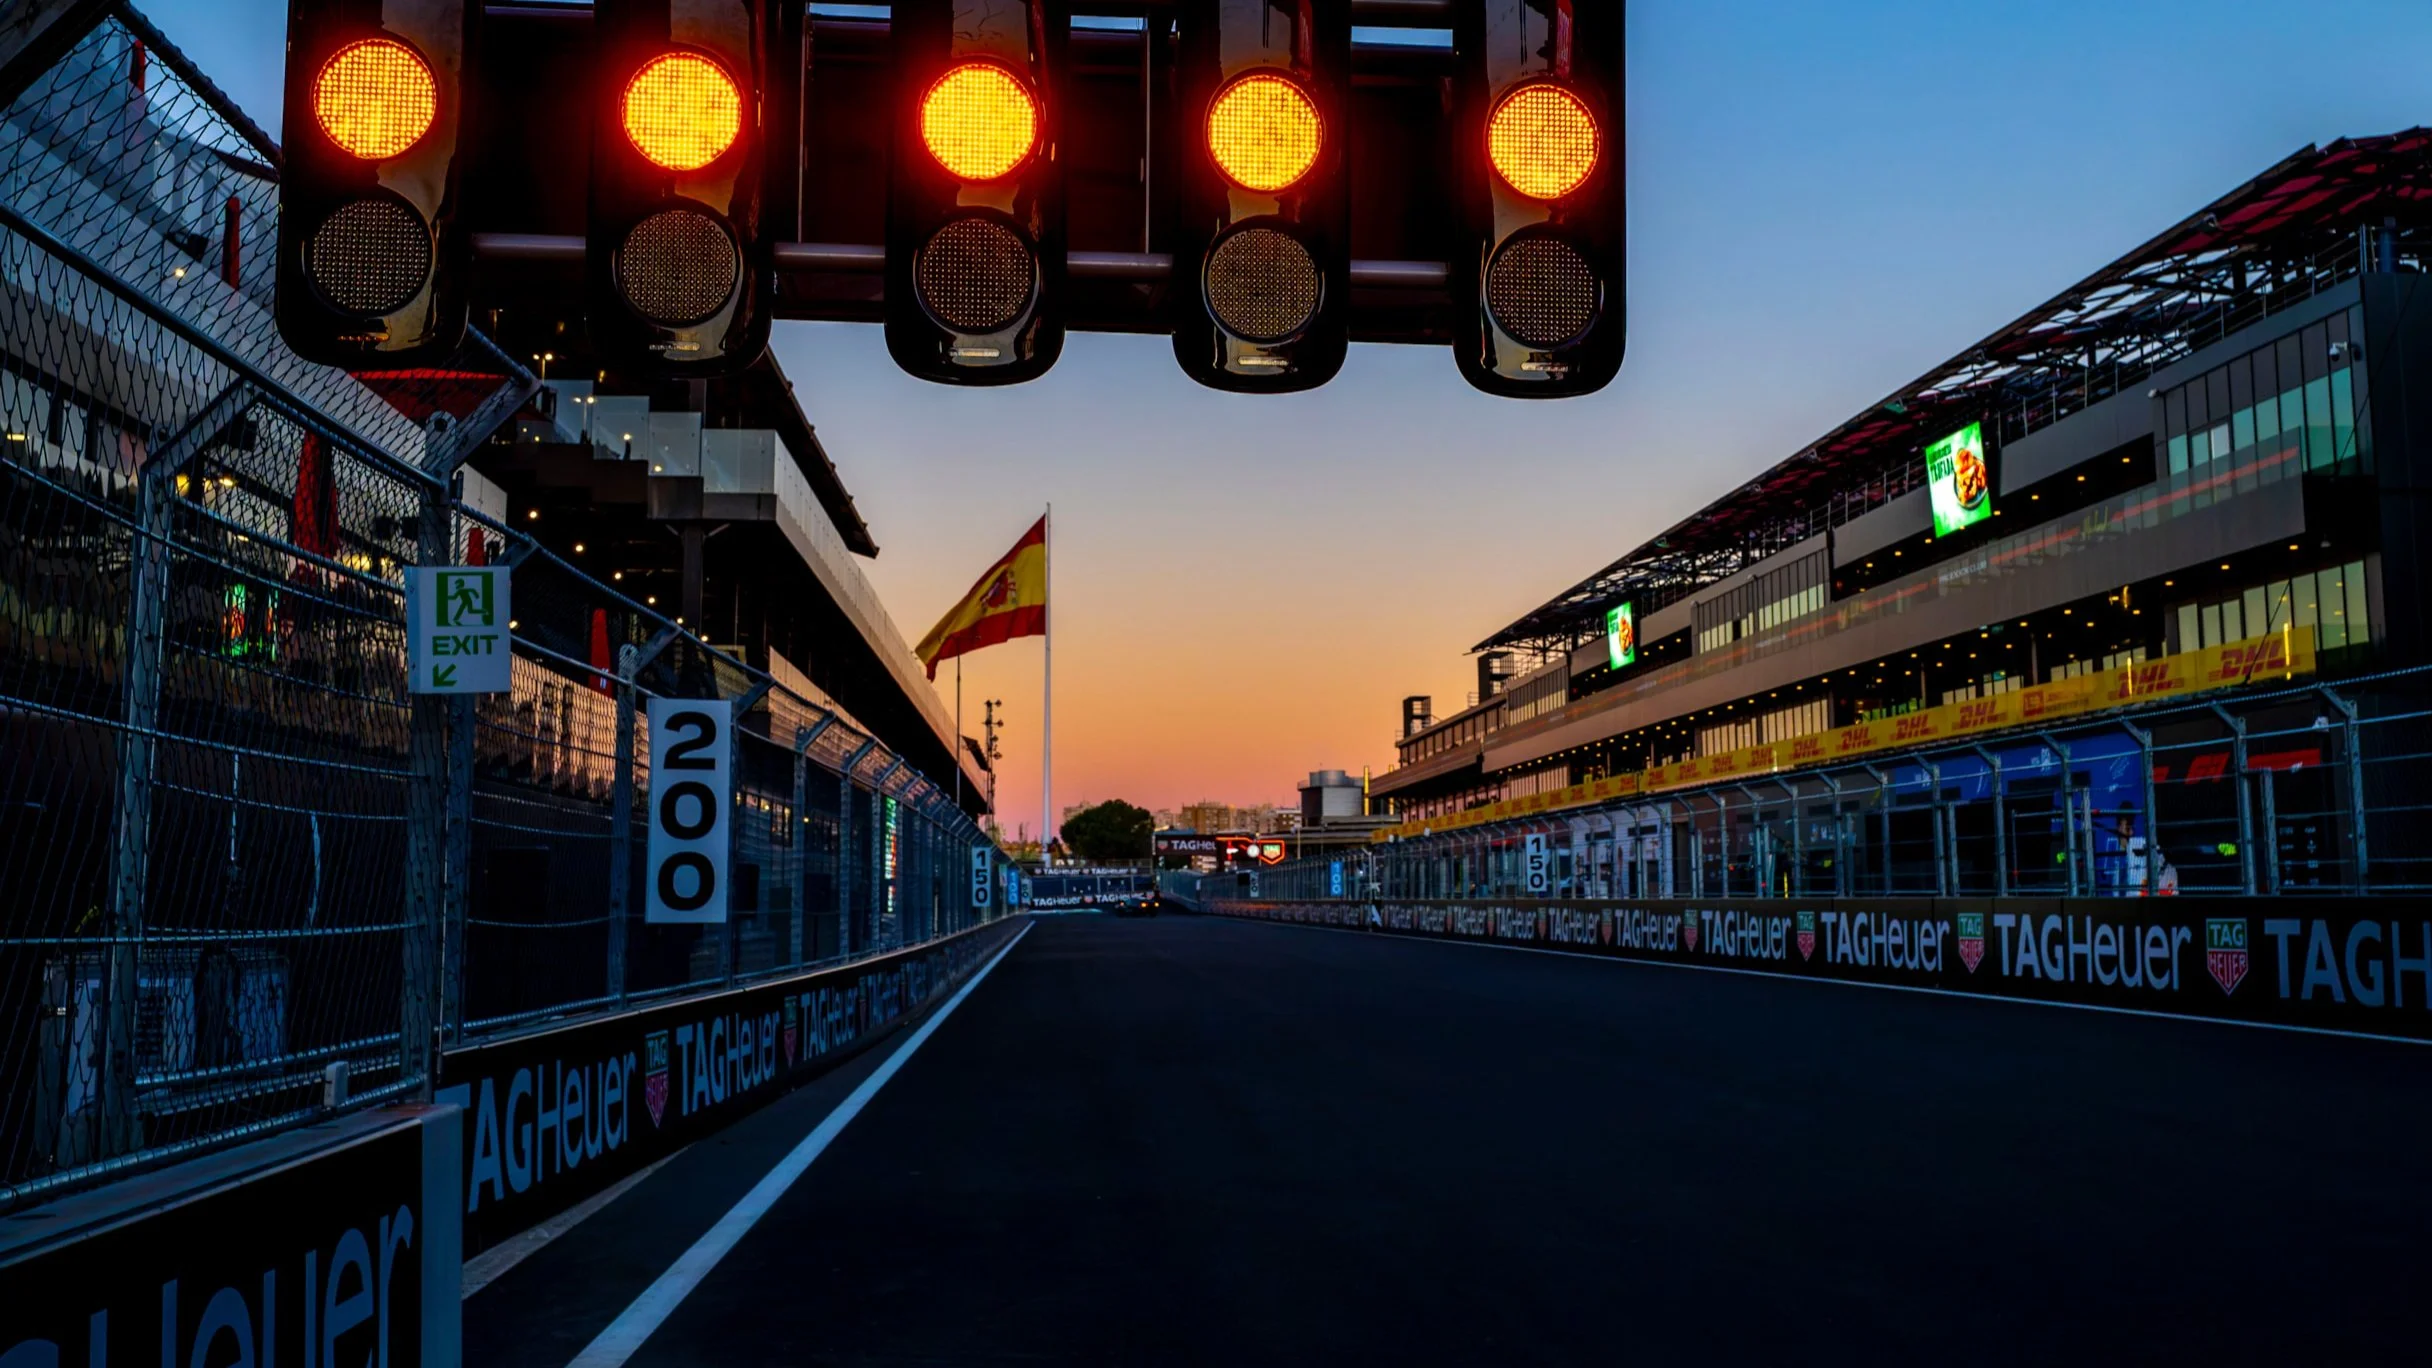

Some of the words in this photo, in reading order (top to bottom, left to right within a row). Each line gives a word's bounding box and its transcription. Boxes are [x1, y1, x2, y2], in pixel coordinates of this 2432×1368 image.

[432, 635, 499, 656] EXIT
[2221, 639, 2287, 679] DHL
[2118, 663, 2177, 698] DHL
[1895, 714, 1933, 740] DHL
[1959, 700, 2002, 728] DHL
[657, 711, 717, 911] 200
[975, 850, 988, 903] 150
[1332, 863, 1341, 894] 100
[1530, 837, 1544, 888] 150
[1960, 917, 1982, 936] TAG
[2210, 923, 2245, 947] TAG
[1614, 908, 1681, 951] TAGHeuer
[1701, 910, 1792, 960] TAGHeuer
[1820, 911, 1950, 973] TAGHeuer
[1993, 913, 2192, 992] TAGHeuer
[2263, 917, 2432, 1012] TAGH
[2208, 951, 2248, 989] HEUER
[675, 1009, 780, 1117] TAGHeuer
